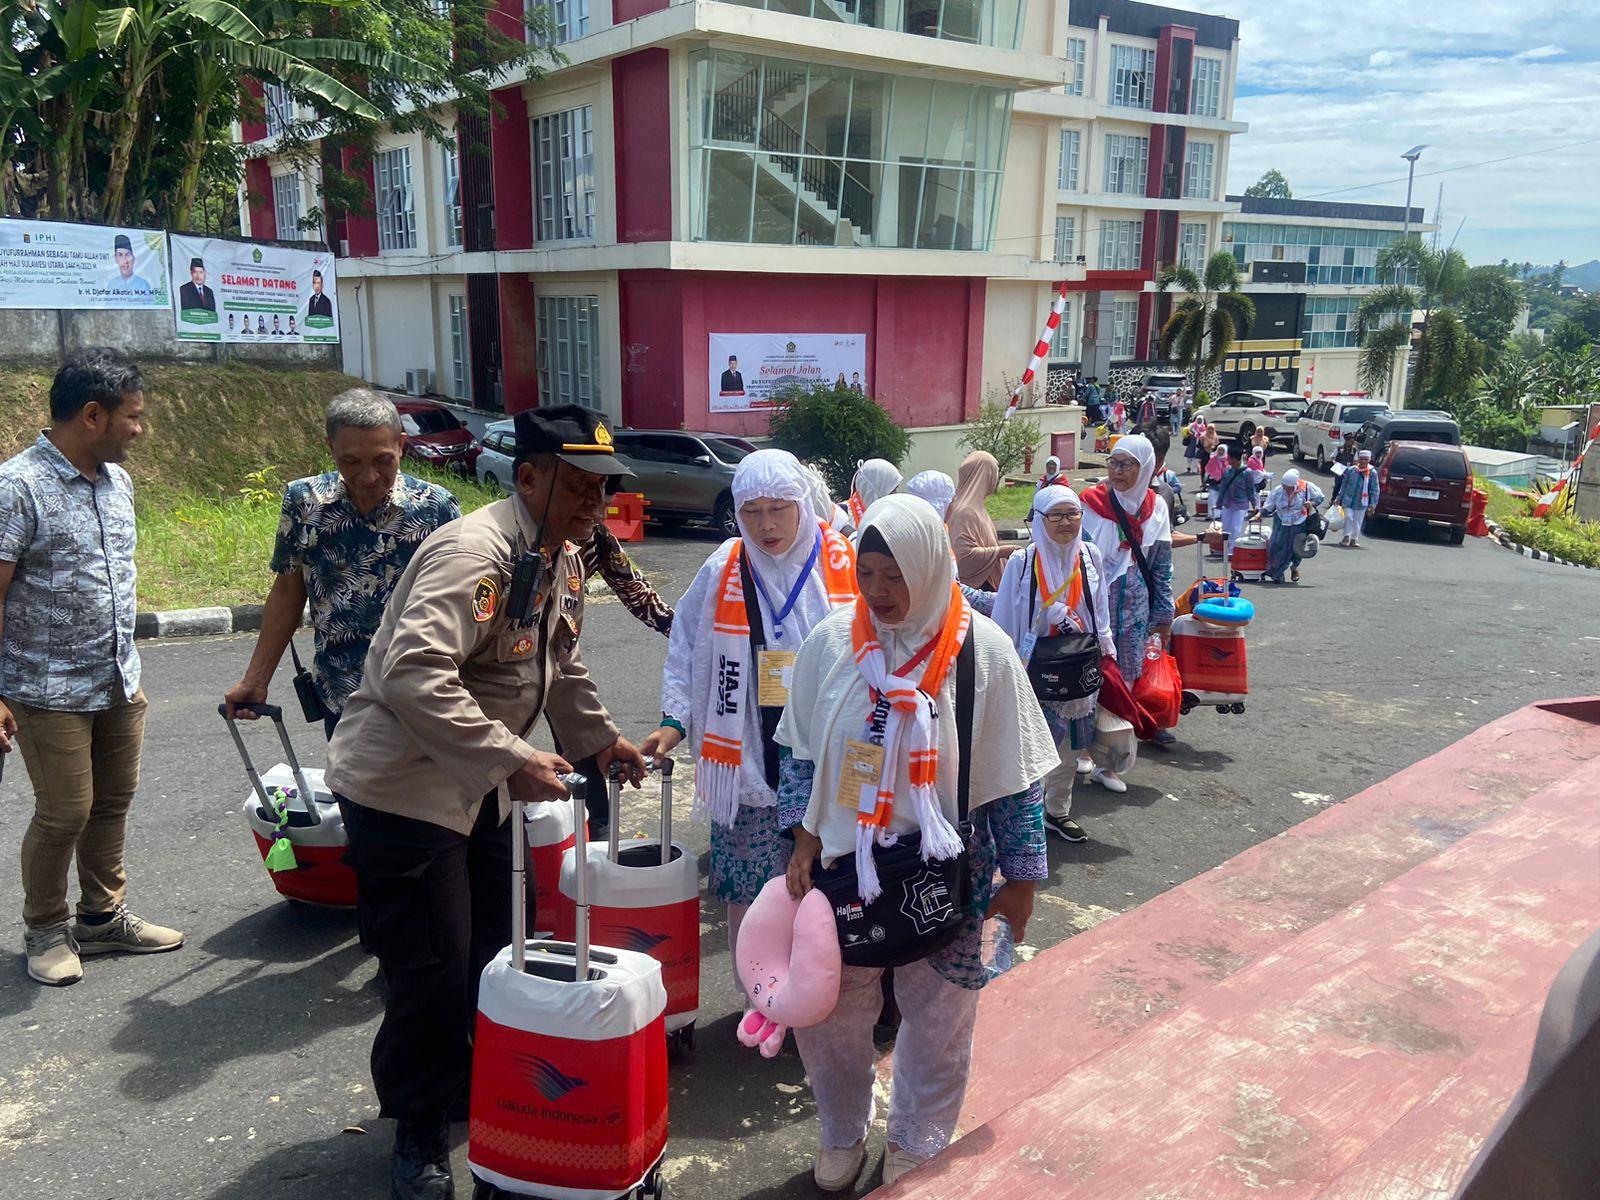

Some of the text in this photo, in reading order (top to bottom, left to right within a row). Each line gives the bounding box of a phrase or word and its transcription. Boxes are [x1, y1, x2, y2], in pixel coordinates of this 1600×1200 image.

[35, 234, 56, 242] IPHI
[46, 250, 69, 258] SEBAGAI
[70, 251, 83, 259] TAMU
[84, 252, 98, 260] ALLAH
[21, 260, 47, 268] SULAWESI
[221, 274, 297, 290] SELAMAT DATANG
[759, 365, 821, 376] Selamat Jalan
[715, 653, 726, 717] 2023
[725, 659, 740, 714] HAJI
[836, 903, 852, 922] Haji
[850, 911, 864, 920] 2023
[496, 1095, 598, 1125] Garuda Indonesia
